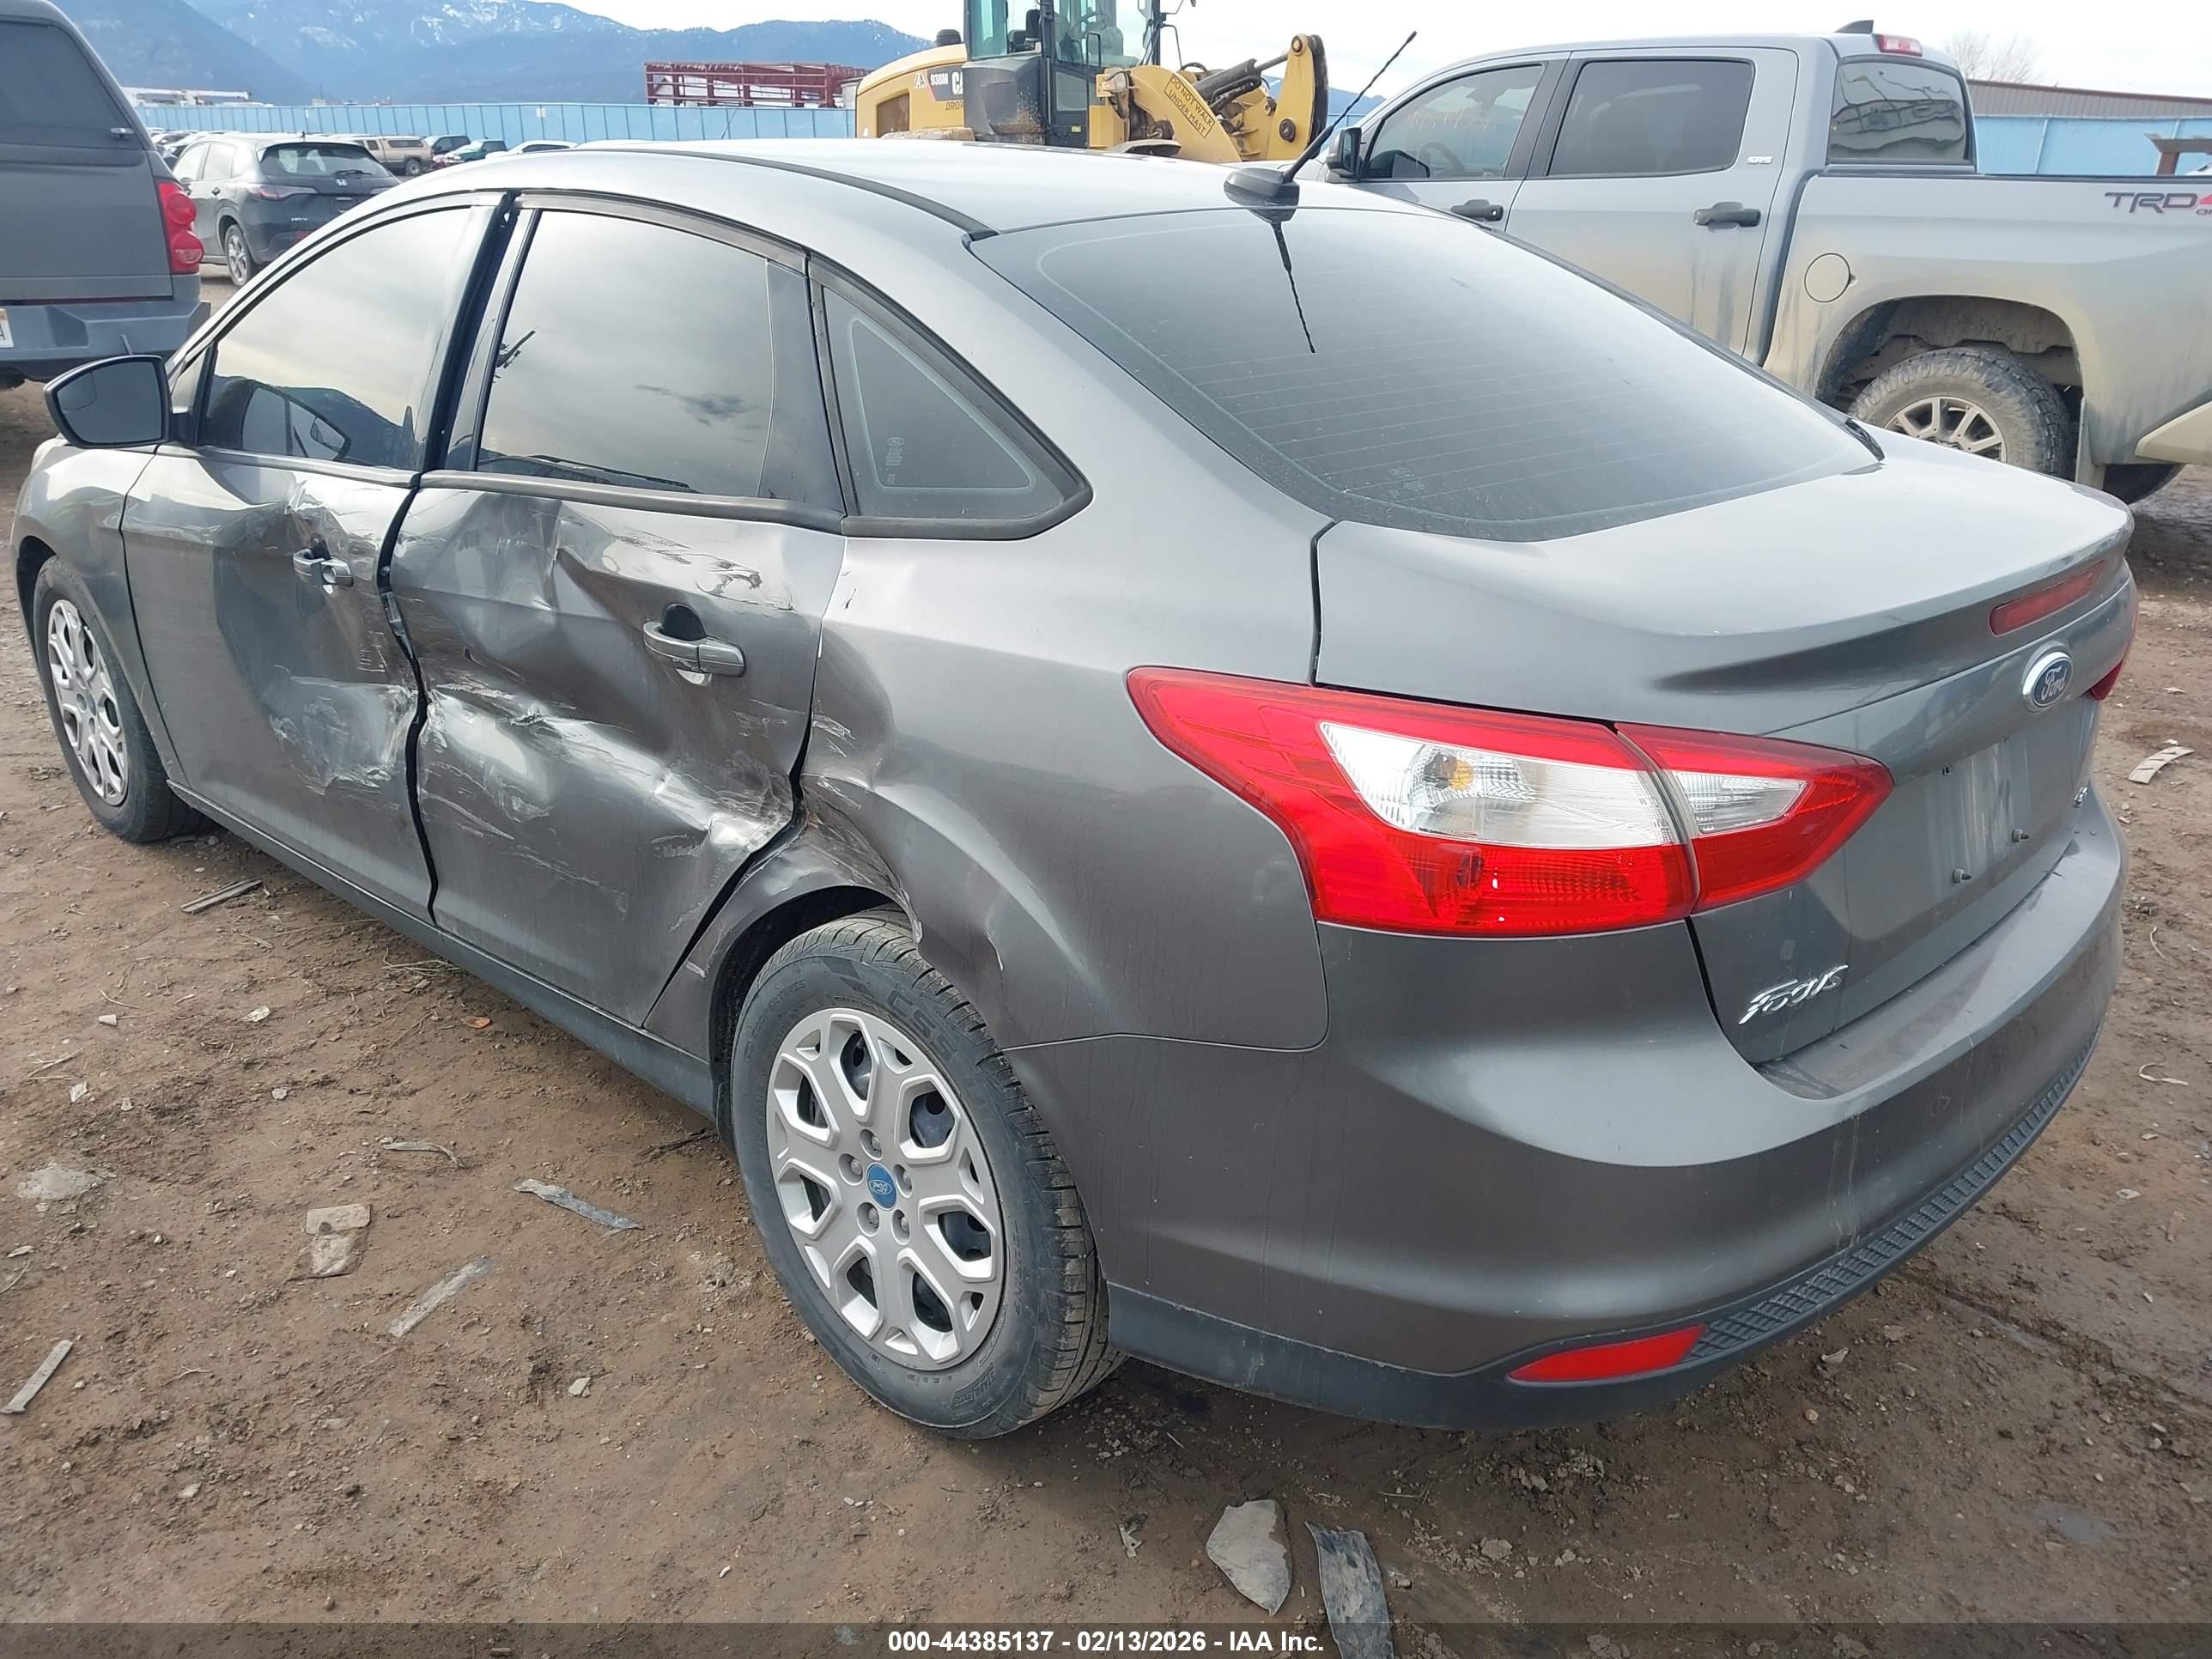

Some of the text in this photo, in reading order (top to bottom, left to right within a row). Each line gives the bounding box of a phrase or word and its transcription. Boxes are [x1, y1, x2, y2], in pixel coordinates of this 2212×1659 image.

[930, 73, 948, 85] 938M
[1169, 90, 1206, 132] UNDER MAST
[1170, 76, 1212, 126] DO NOT WALK
[2105, 192, 2197, 213] TRD
[2040, 665, 2068, 701] Ford
[1738, 963, 1849, 1024] Focus
